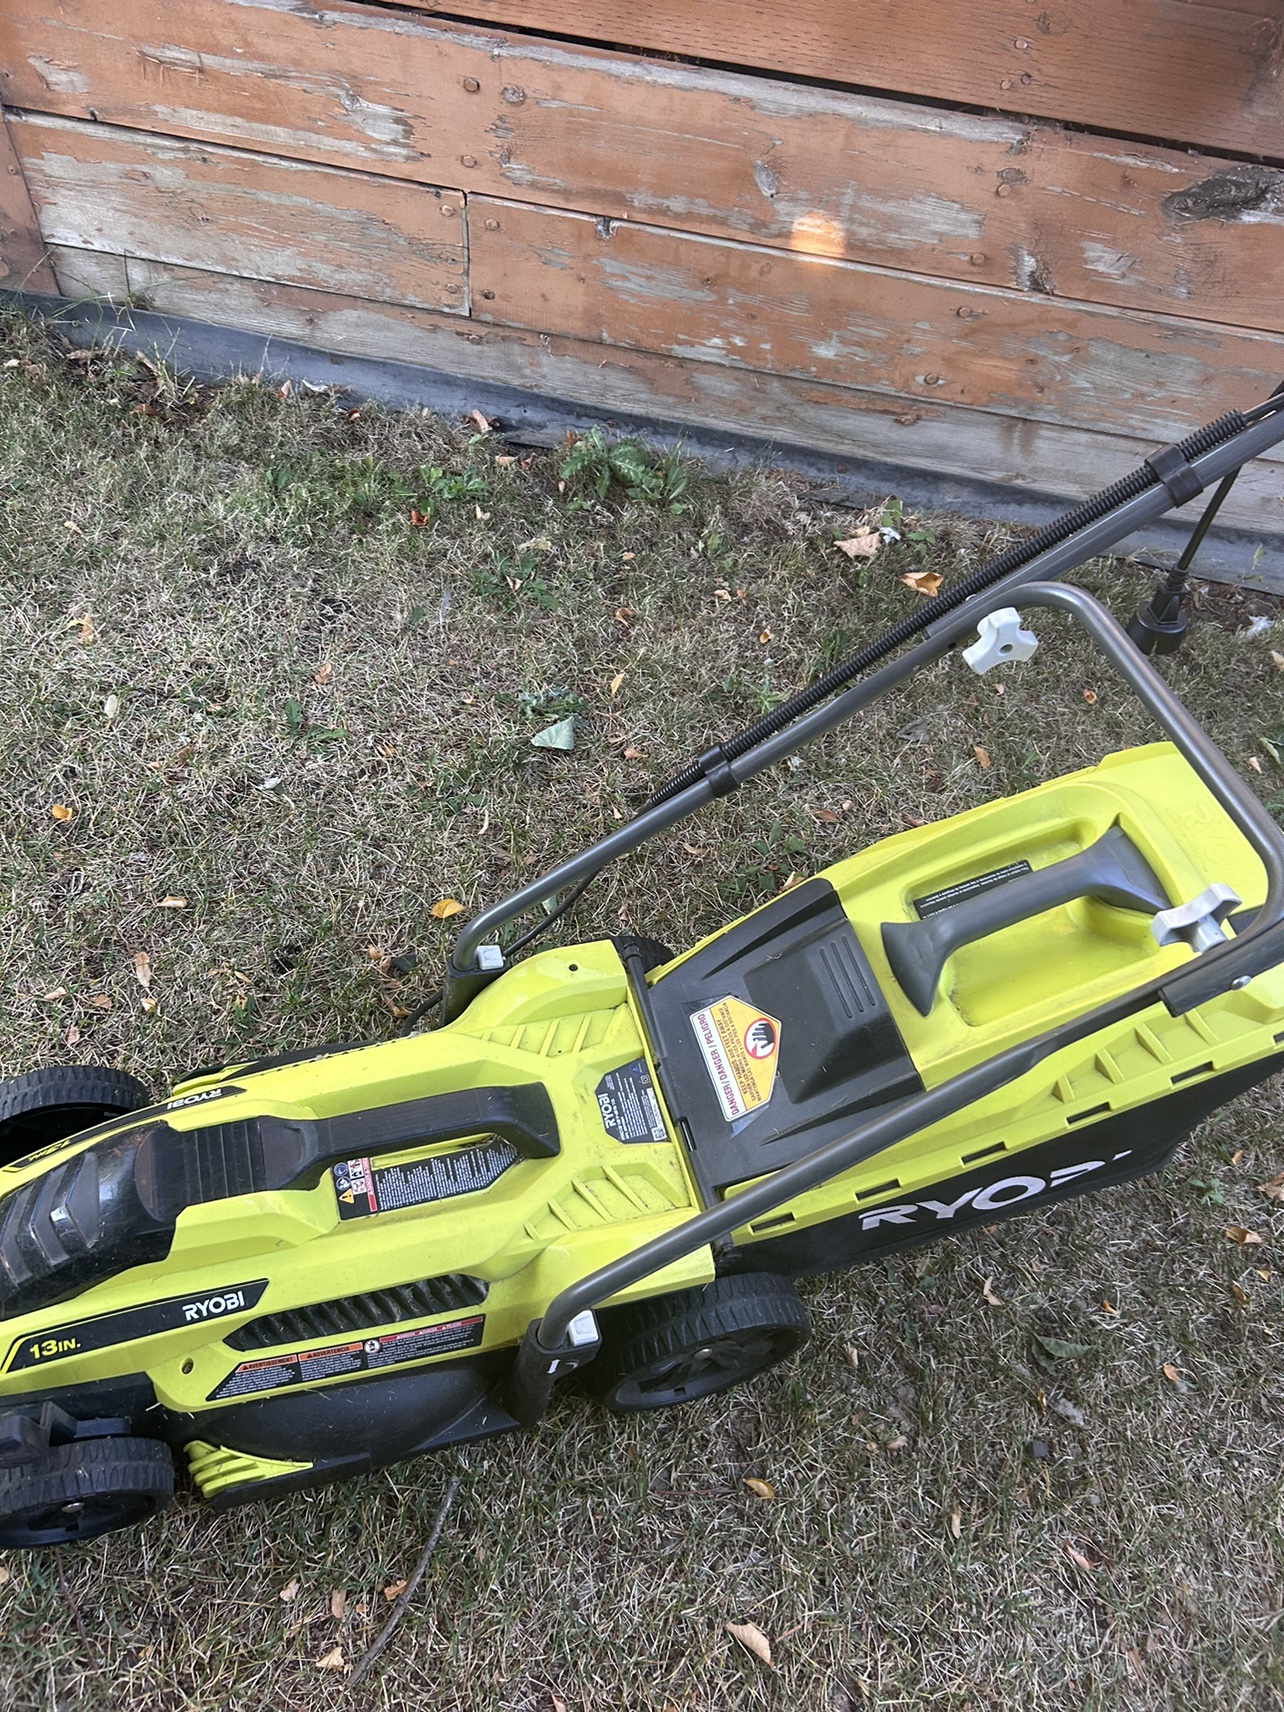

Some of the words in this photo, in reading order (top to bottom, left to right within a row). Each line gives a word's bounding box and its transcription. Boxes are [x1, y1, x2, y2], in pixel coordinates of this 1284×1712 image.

[698, 1013, 714, 1044] PELIGRO
[717, 1019, 726, 1034] AWAY
[722, 1035, 731, 1048] FEET
[711, 1049, 728, 1080] DANGER
[732, 1060, 742, 1080] HANDS
[739, 1080, 748, 1094] KEEP
[167, 1088, 223, 1110] RYOBI
[723, 1083, 740, 1115] DANGER
[598, 1093, 616, 1128] RYOBI
[182, 1290, 245, 1321] RYOBI
[29, 1337, 82, 1359] 13IN.
[312, 1346, 350, 1358] ADVERTENCIA
[248, 1356, 294, 1370] AVERTISSEMENT
